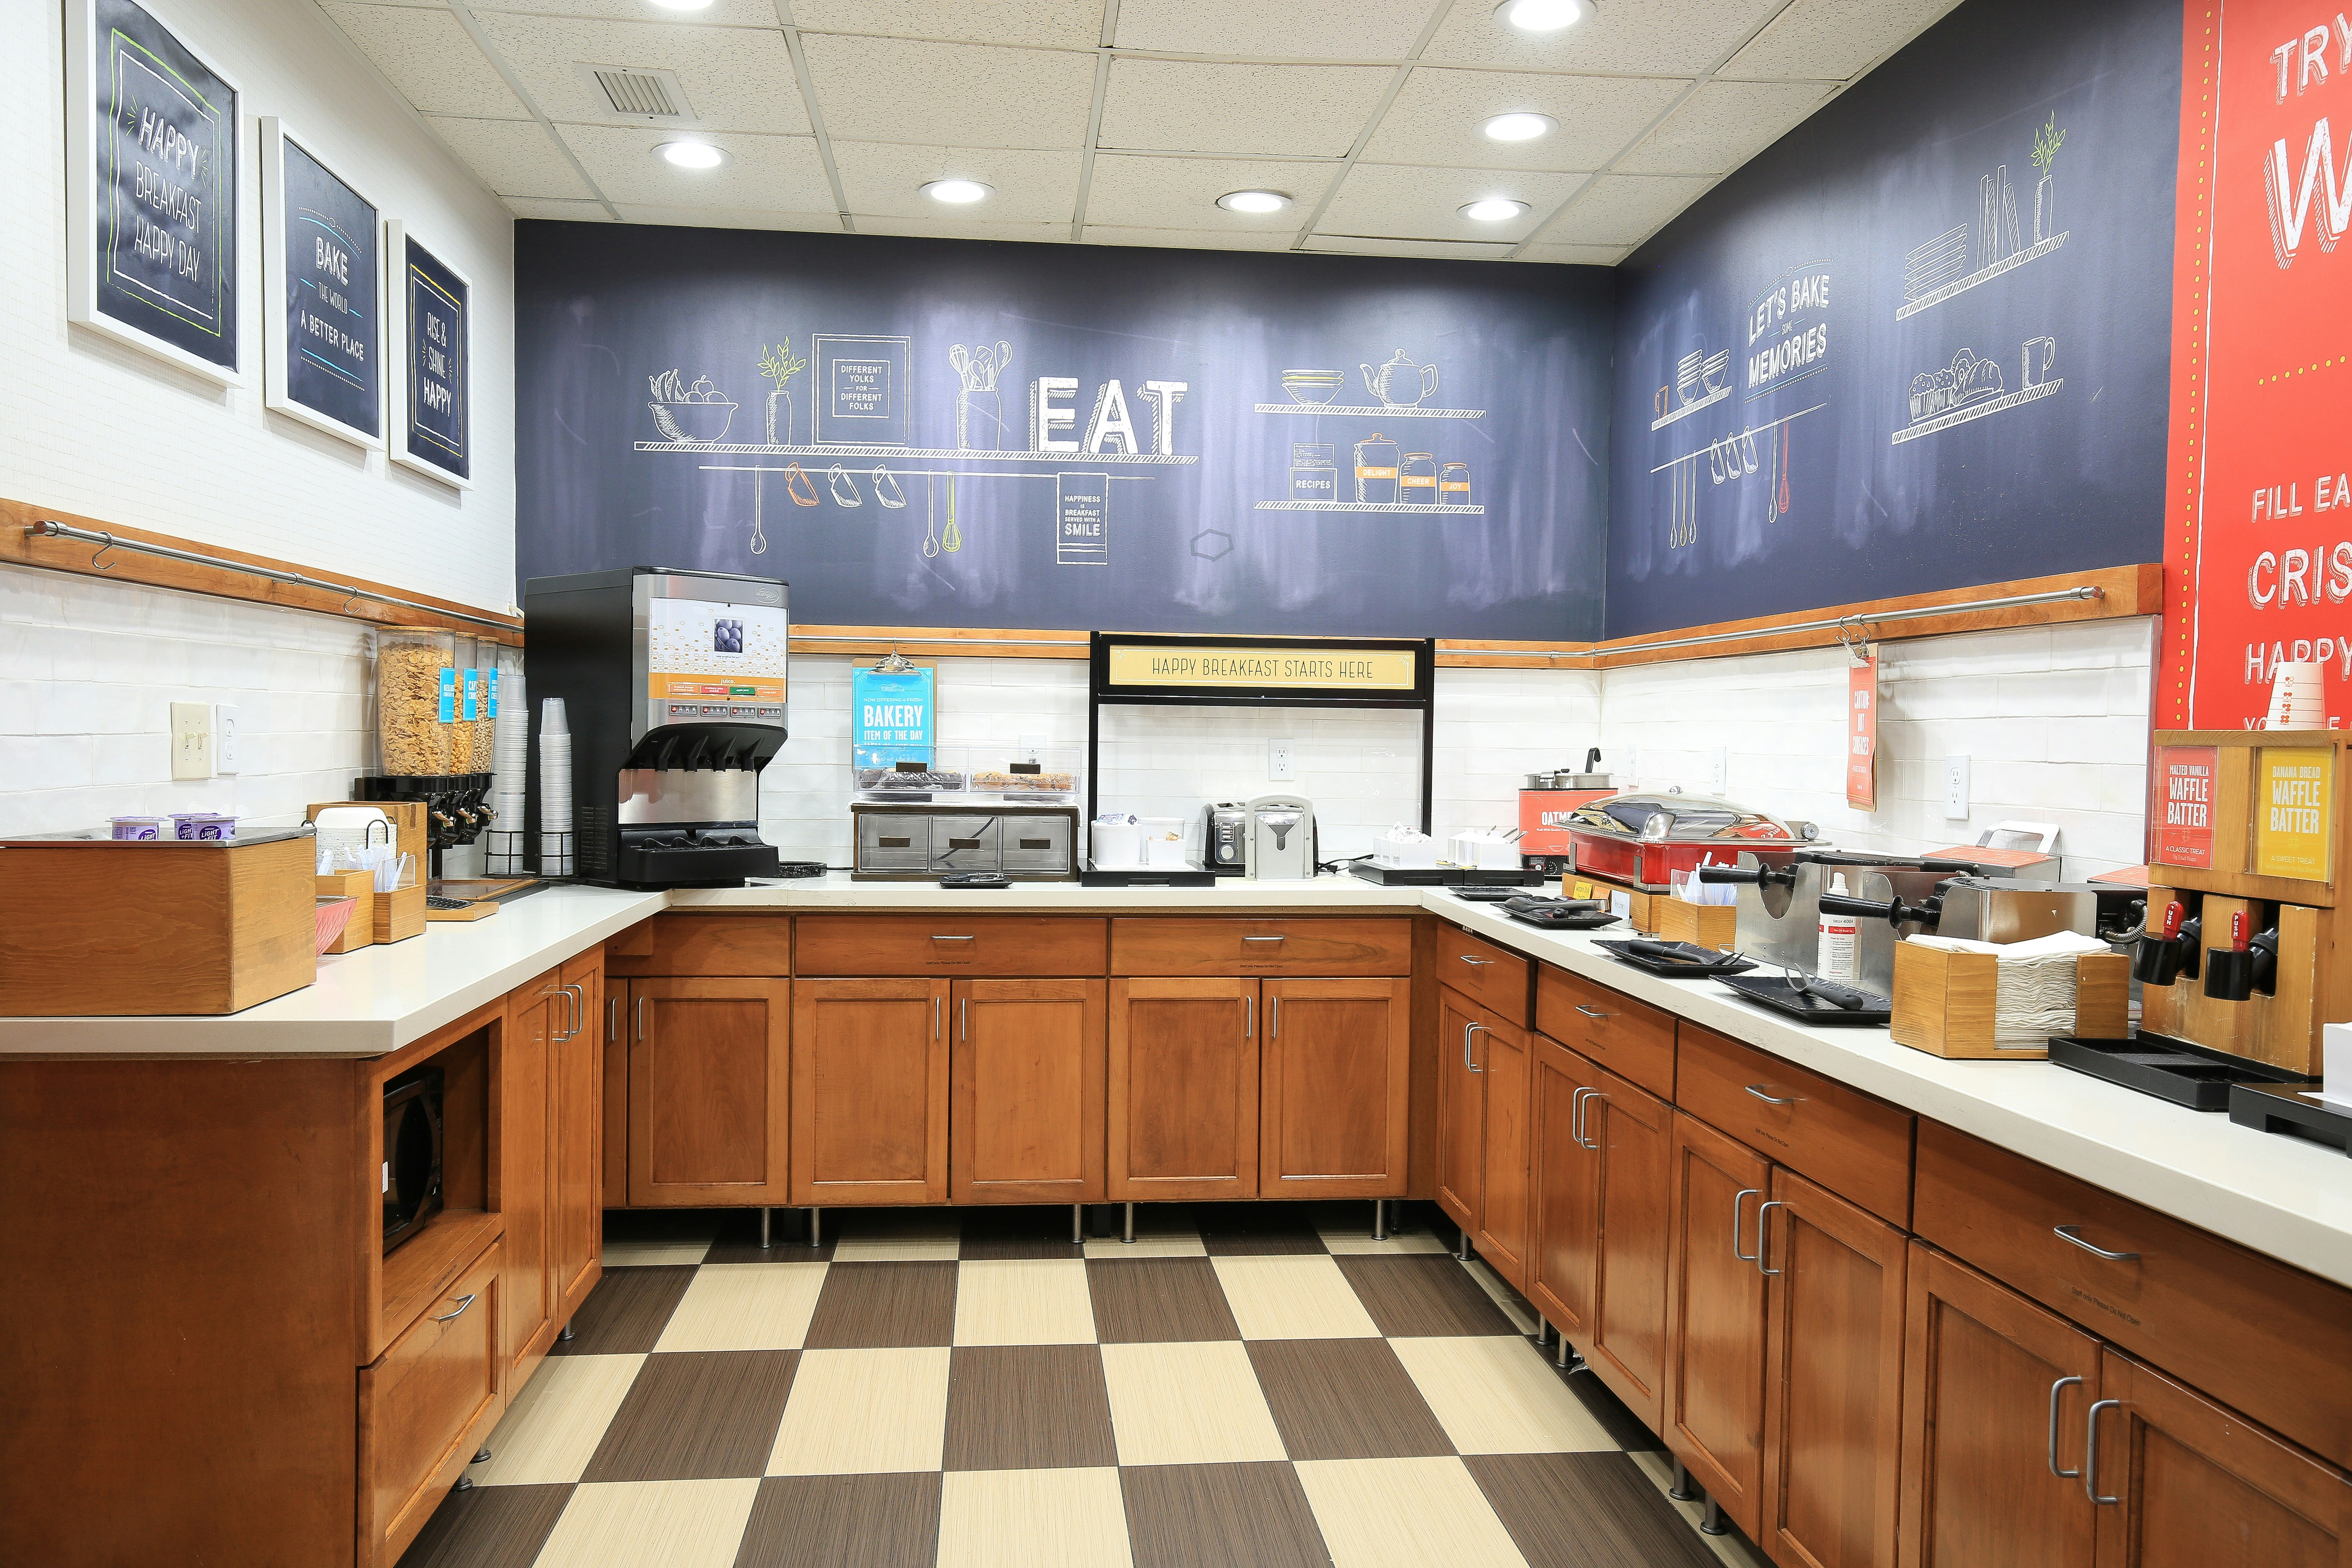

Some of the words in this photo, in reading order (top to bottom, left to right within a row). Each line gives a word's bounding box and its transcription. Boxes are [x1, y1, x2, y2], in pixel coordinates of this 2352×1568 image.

[2269, 12, 2352, 105] TRY
[138, 106, 199, 180] HAPPY
[136, 160, 202, 234] BREAKFAST
[134, 215, 175, 269] HAPPY
[179, 241, 200, 282] DAY
[316, 236, 348, 286] BAKE
[318, 282, 328, 303] THE
[330, 289, 348, 314] WORLD
[1749, 287, 1786, 347] LET'S
[1791, 274, 1830, 313] BAKE
[301, 310, 307, 330] A
[310, 314, 339, 348] BETTER
[341, 332, 364, 362] PLACE
[427, 312, 440, 343] RISE
[441, 322, 447, 348] &
[1782, 320, 1793, 336] SOME
[429, 346, 446, 379] SHINE
[1748, 323, 1827, 389] MEMORIES
[841, 365, 882, 374] DIFFERENT
[849, 374, 874, 383] YOLKS
[424, 376, 451, 417] HAPPY
[841, 393, 882, 401] DIFFERENT
[849, 402, 874, 410] FOLKS
[1029, 376, 1188, 456] EAT
[1296, 480, 1331, 489] RECIPES
[2251, 481, 2303, 523] FILL
[1064, 523, 1100, 536] SMILE
[2247, 540, 2352, 610] CRIS
[1153, 658, 1196, 675] HAPPY
[1203, 659, 1279, 676] BREAKFAST
[1285, 660, 1332, 677] STARTS
[1340, 661, 1373, 678] HERE
[1854, 690, 1870, 709] CAUTION:
[864, 705, 923, 727] BAKERY
[864, 730, 881, 740] ITEM
[883, 730, 892, 740] OF
[894, 730, 908, 740] THE
[910, 730, 923, 740] DAY
[1852, 735, 1869, 756] SURFACES
[2169, 764, 2188, 775] MALTED
[2189, 765, 2209, 776] VANILLA
[2272, 766, 2297, 778] BANANA
[2299, 766, 2321, 779] BREAD
[2169, 777, 2209, 802] WAFFLE
[2272, 780, 2321, 806] WAFFLE
[2167, 802, 2207, 827] BATTER
[2270, 806, 2320, 834] BATTER
[2170, 846, 2189, 854] CLASSIC
[2297, 857, 2316, 865] TREAT
[2166, 905, 2174, 925] USH
[2072, 1287, 2082, 1297] Staff
[2083, 1294, 2092, 1303] only
[2094, 1297, 2109, 1311] Please
[2110, 1306, 2117, 1315] Do
[2118, 1310, 2126, 1320] Not
[2127, 1314, 2140, 1326] Open
